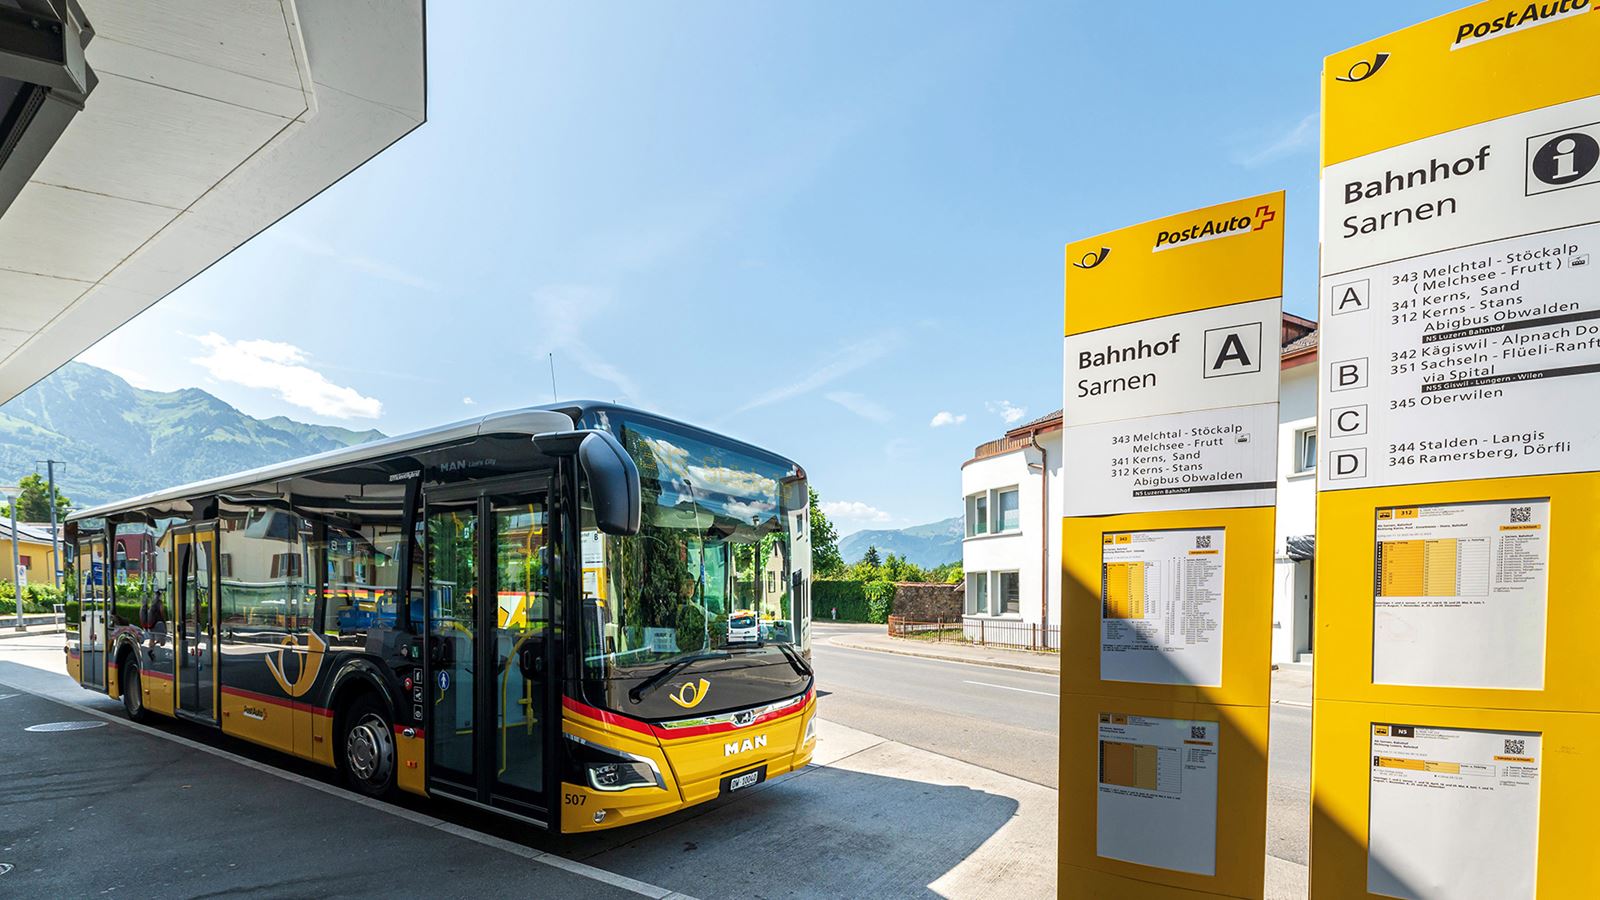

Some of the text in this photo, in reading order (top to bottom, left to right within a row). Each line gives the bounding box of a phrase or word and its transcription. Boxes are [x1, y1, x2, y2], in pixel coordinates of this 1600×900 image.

[1455, 0, 1589, 44] PostAuto
[1344, 145, 1490, 204] Bahnhof
[1344, 197, 1456, 238] Sarnen
[1156, 216, 1251, 247] PostAuto
[1392, 272, 1418, 285] 343
[1423, 257, 1491, 279] Melchtal
[1507, 243, 1579, 264] Stöckalp
[1423, 271, 1496, 292] Melchsee
[1511, 259, 1552, 276] Frutt
[1339, 287, 1362, 309] A
[1392, 280, 1520, 312] 341 Kerns, Sand
[1392, 312, 1417, 325] 312
[1423, 304, 1466, 319] Kerns
[1480, 295, 1523, 310] Stans
[1424, 301, 1580, 333] Abigbus Obwalden
[1439, 330, 1467, 340] Luzern
[1469, 325, 1505, 335] Bahnhof
[1079, 333, 1251, 370] Bahnhof A
[1391, 349, 1417, 362] 342
[1422, 339, 1487, 358] Kägiswil
[1502, 327, 1570, 347] Alpnach
[1391, 363, 1416, 375] 351
[1421, 352, 1488, 371] Sachseln
[1423, 365, 1496, 384] via Spital
[1078, 372, 1156, 397] Sarnen
[1339, 364, 1359, 386] B
[1444, 380, 1469, 390] Giswil
[1476, 376, 1511, 386] Lungern
[1518, 371, 1543, 380] Wilen
[1390, 388, 1503, 410] 345 Oberwilen
[1337, 410, 1359, 432] C
[1112, 436, 1130, 444] 343
[1134, 430, 1181, 442] Melchtal
[1192, 424, 1242, 436] Stöckalp
[1389, 443, 1415, 453] 344
[1420, 436, 1478, 451] Stalden
[1493, 431, 1545, 446] Langis
[1133, 442, 1184, 453] Melchsee
[1195, 438, 1223, 447] Frutt
[1389, 441, 1571, 467] 346 Ramersberg, Dörfli
[441, 460, 465, 472] MAN
[1112, 451, 1200, 466] 341 Kerns, Sand
[1337, 454, 1358, 475] D
[1112, 469, 1129, 477] 312
[1133, 466, 1162, 475] Kerns
[1173, 463, 1202, 472] Stans
[1134, 471, 1242, 486] Abigbus Obwalden
[724, 735, 767, 756] MAN
[564, 794, 586, 806] 507
